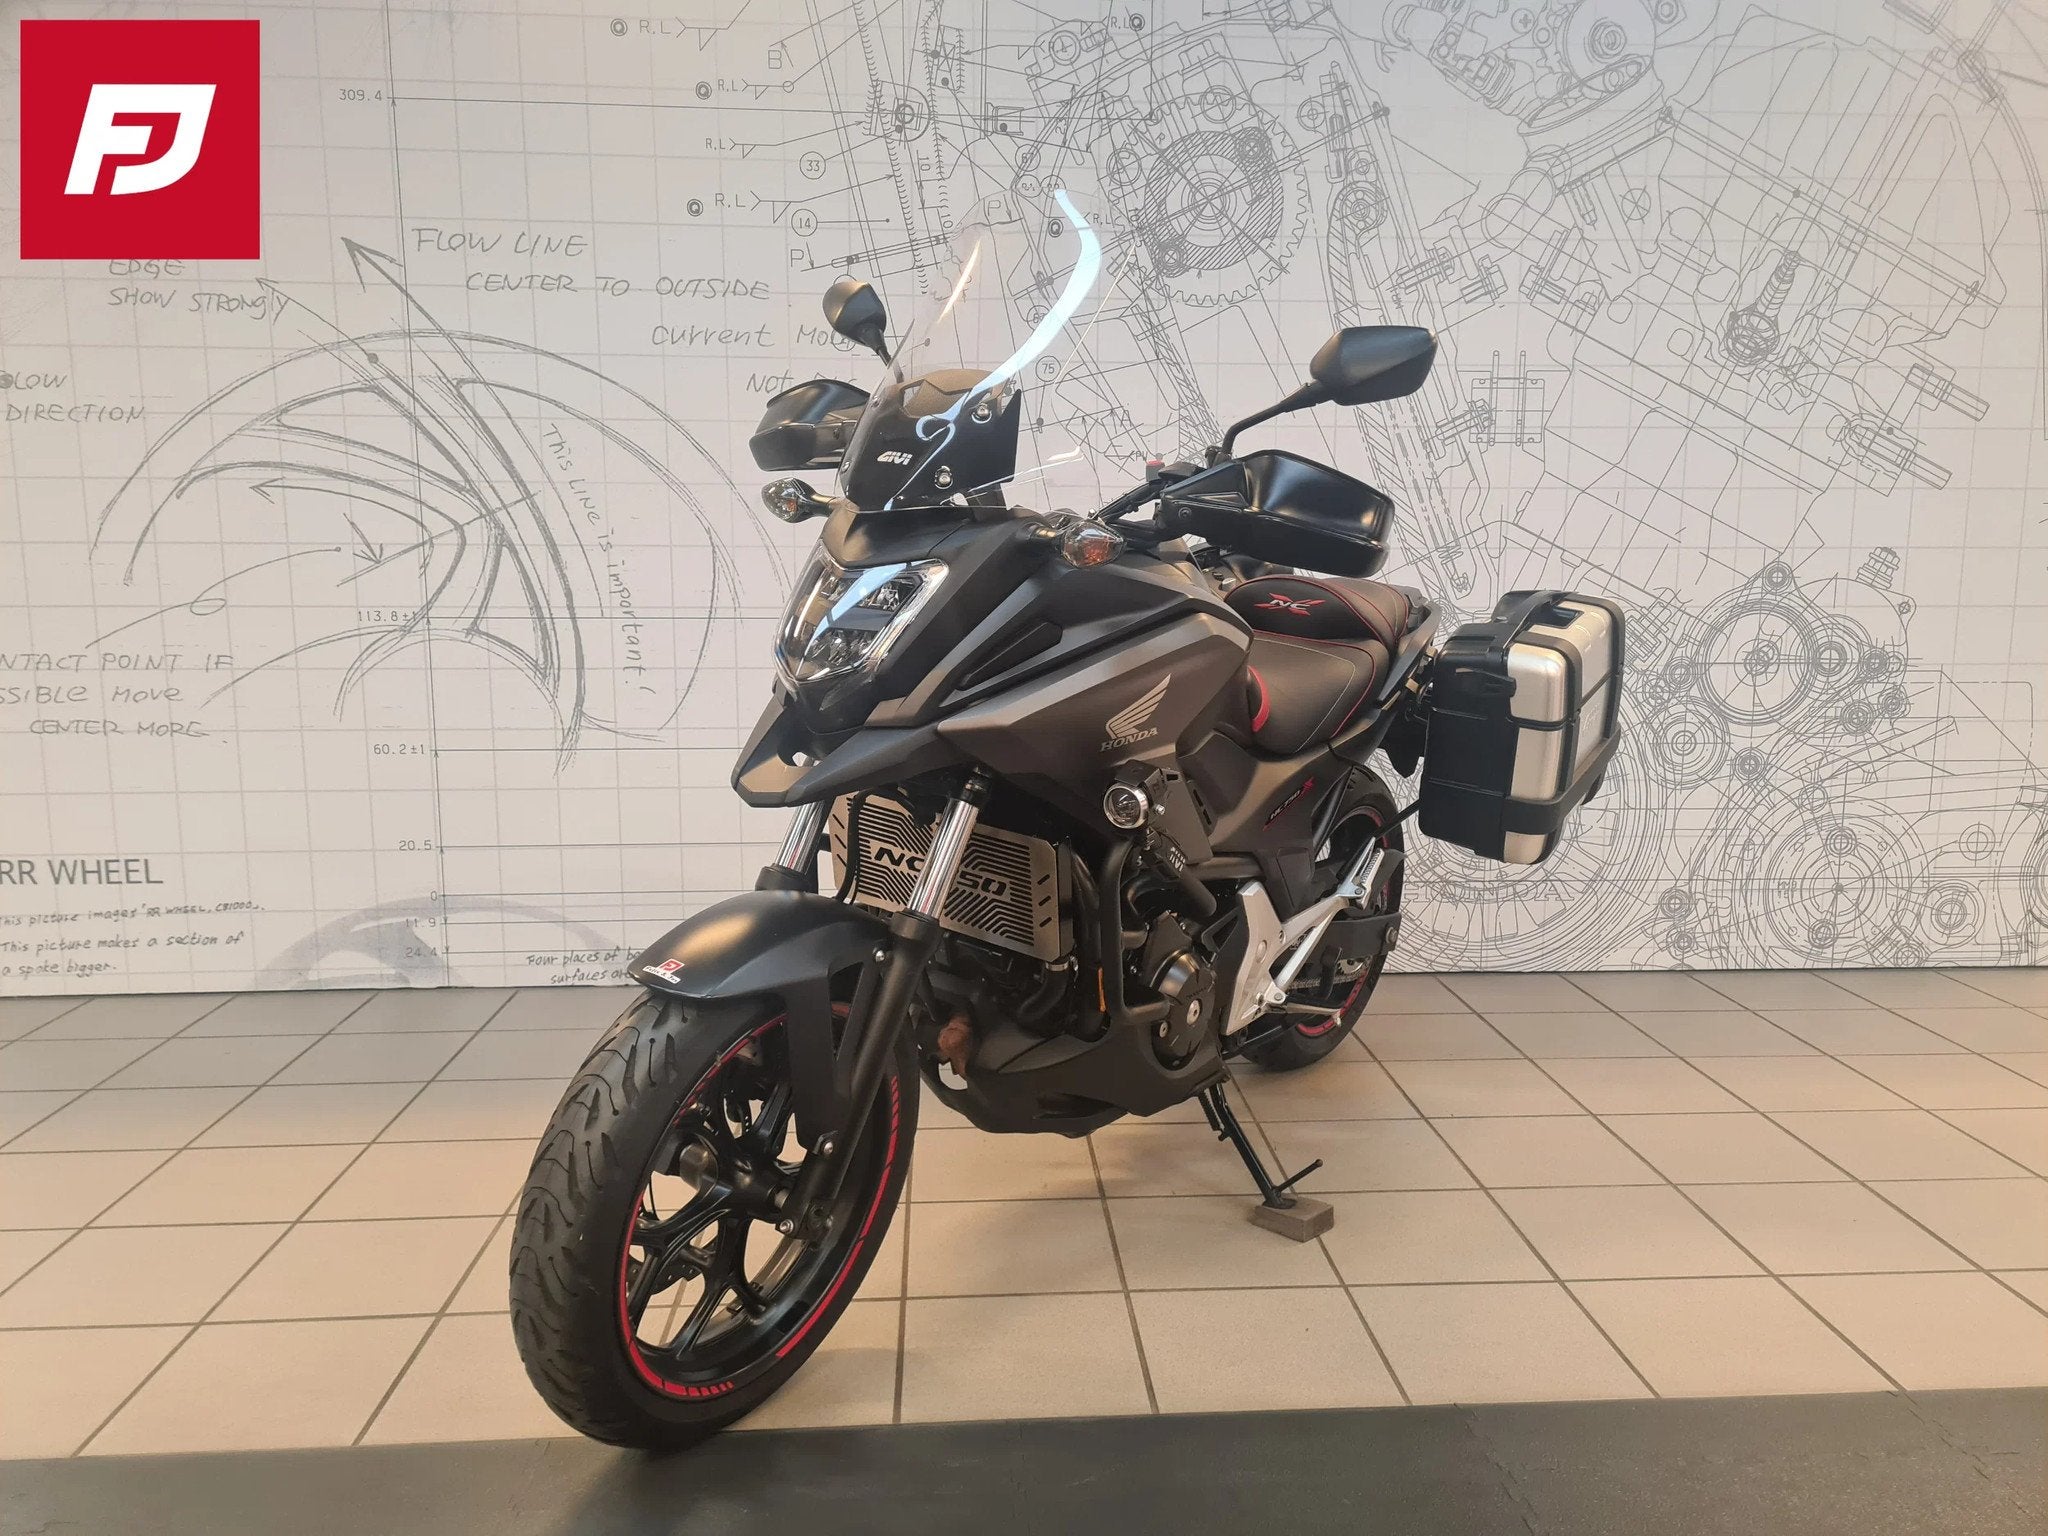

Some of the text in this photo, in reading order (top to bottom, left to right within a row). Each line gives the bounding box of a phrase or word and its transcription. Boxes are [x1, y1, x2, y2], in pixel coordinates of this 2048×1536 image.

[767, 49, 783, 70] B
[338, 88, 382, 101] 309.4
[805, 158, 821, 172] 33
[798, 216, 812, 230] 14
[411, 228, 588, 257] FLOW LINE
[789, 248, 805, 268] P
[465, 271, 770, 300] CENTER TO OUTSIDE
[107, 287, 177, 308] SHOW
[1041, 362, 1056, 375] 75
[5, 403, 145, 423] DIRECTION
[876, 450, 913, 466] GIVI
[101, 652, 184, 673] POINT
[205, 654, 234, 673] IF
[30, 719, 124, 737] CENTER
[1100, 727, 1159, 753] HONDA
[398, 840, 432, 852] 20.5
[47, 858, 164, 885] WHEEL
[36, 938, 92, 957] picture
[146, 937, 158, 947] a
[225, 931, 245, 945] of
[2, 965, 12, 977] a
